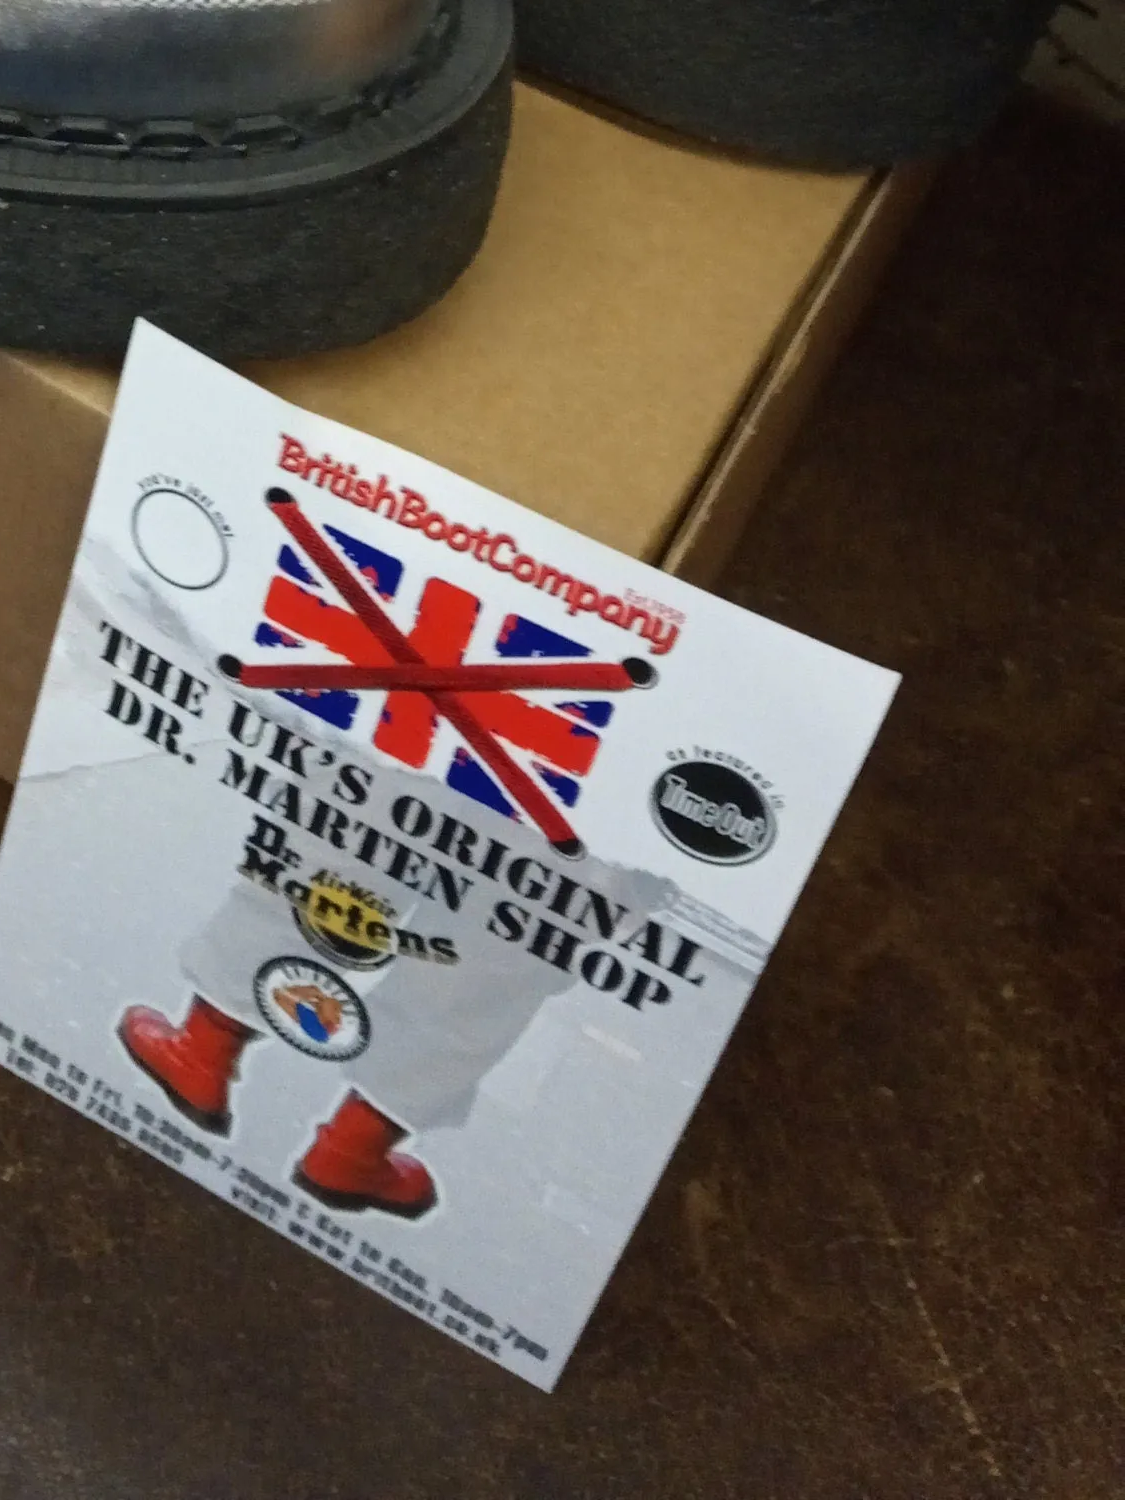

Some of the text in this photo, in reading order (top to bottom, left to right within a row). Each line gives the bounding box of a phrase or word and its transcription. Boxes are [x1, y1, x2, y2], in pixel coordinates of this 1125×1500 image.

[99, 620, 706, 988] THE UK'S ORIGINAL
[104, 679, 196, 766] DR.
[218, 748, 474, 912] MARTEN
[486, 900, 673, 1011] SHOP
[237, 843, 462, 964] Martens
